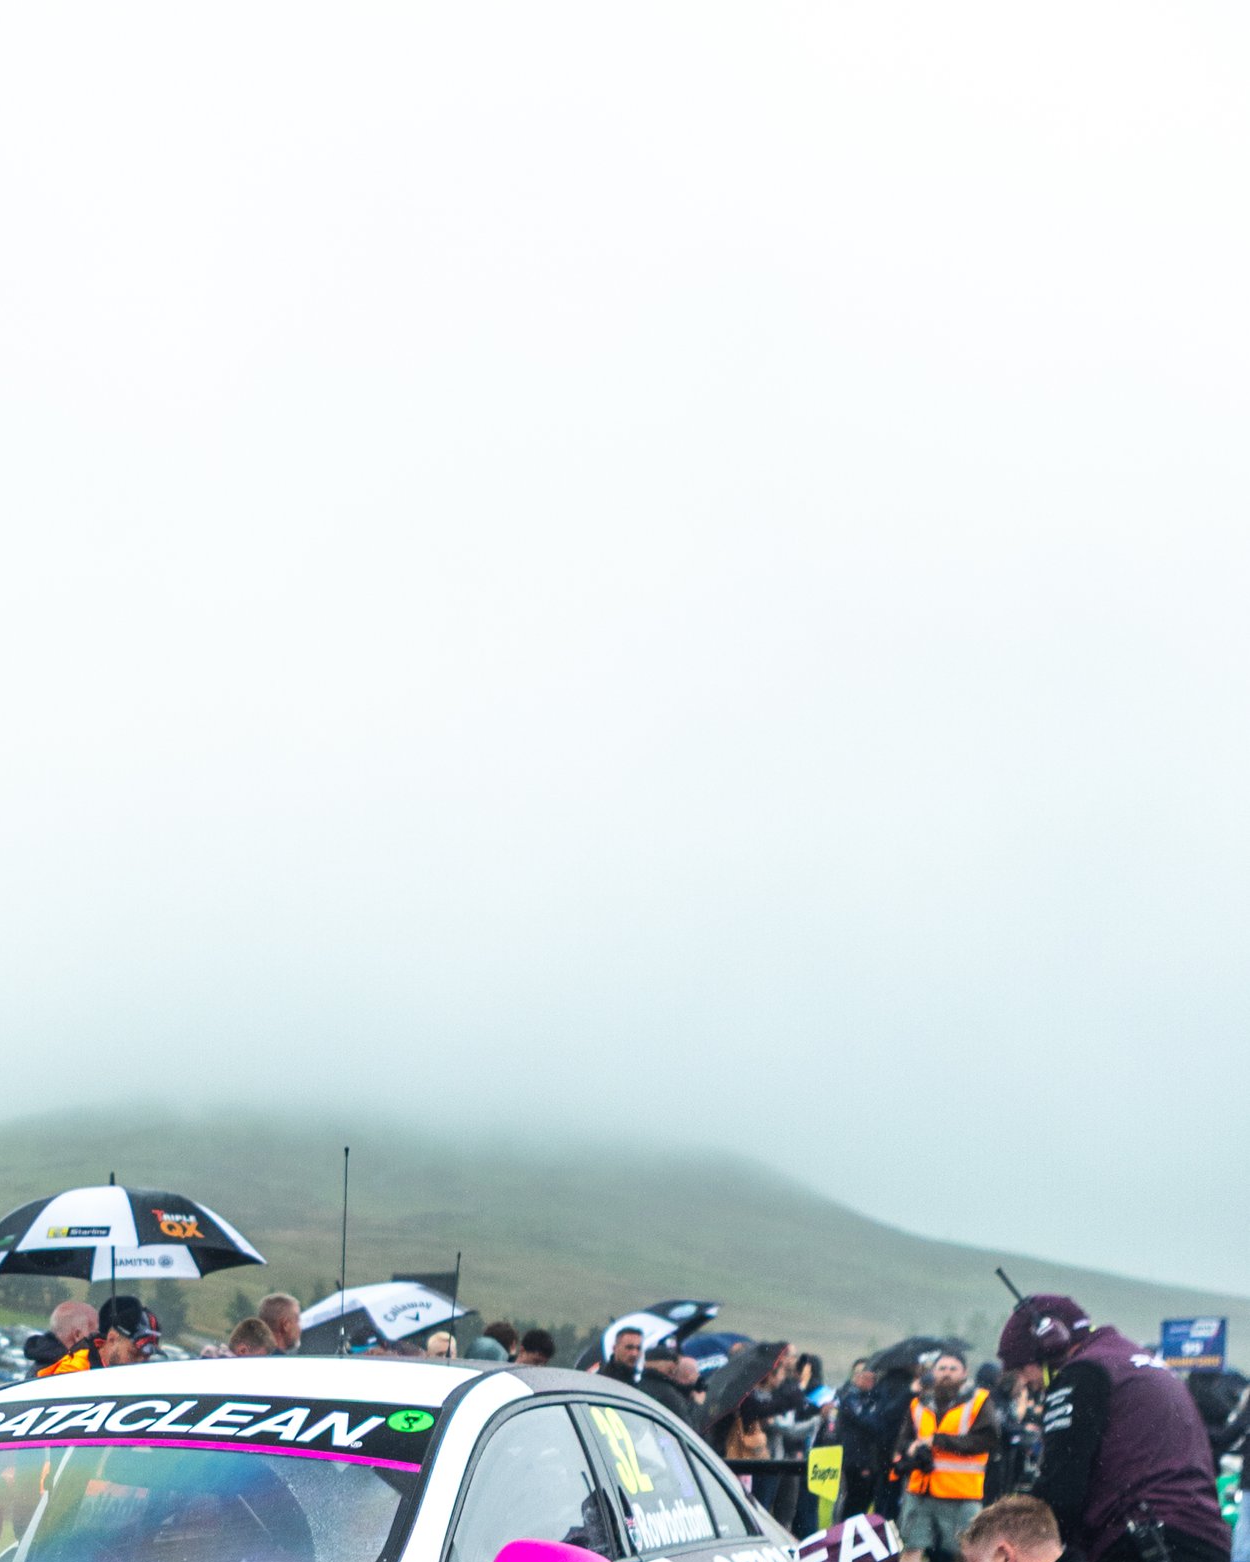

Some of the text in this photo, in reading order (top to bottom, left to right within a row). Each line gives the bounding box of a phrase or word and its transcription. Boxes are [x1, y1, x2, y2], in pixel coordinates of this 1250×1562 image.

[152, 1209, 197, 1223] TRIPLE
[69, 1227, 110, 1237] Starline
[161, 1221, 205, 1239] QX
[383, 1301, 433, 1323] Callaway
[590, 1406, 655, 1495] 32
